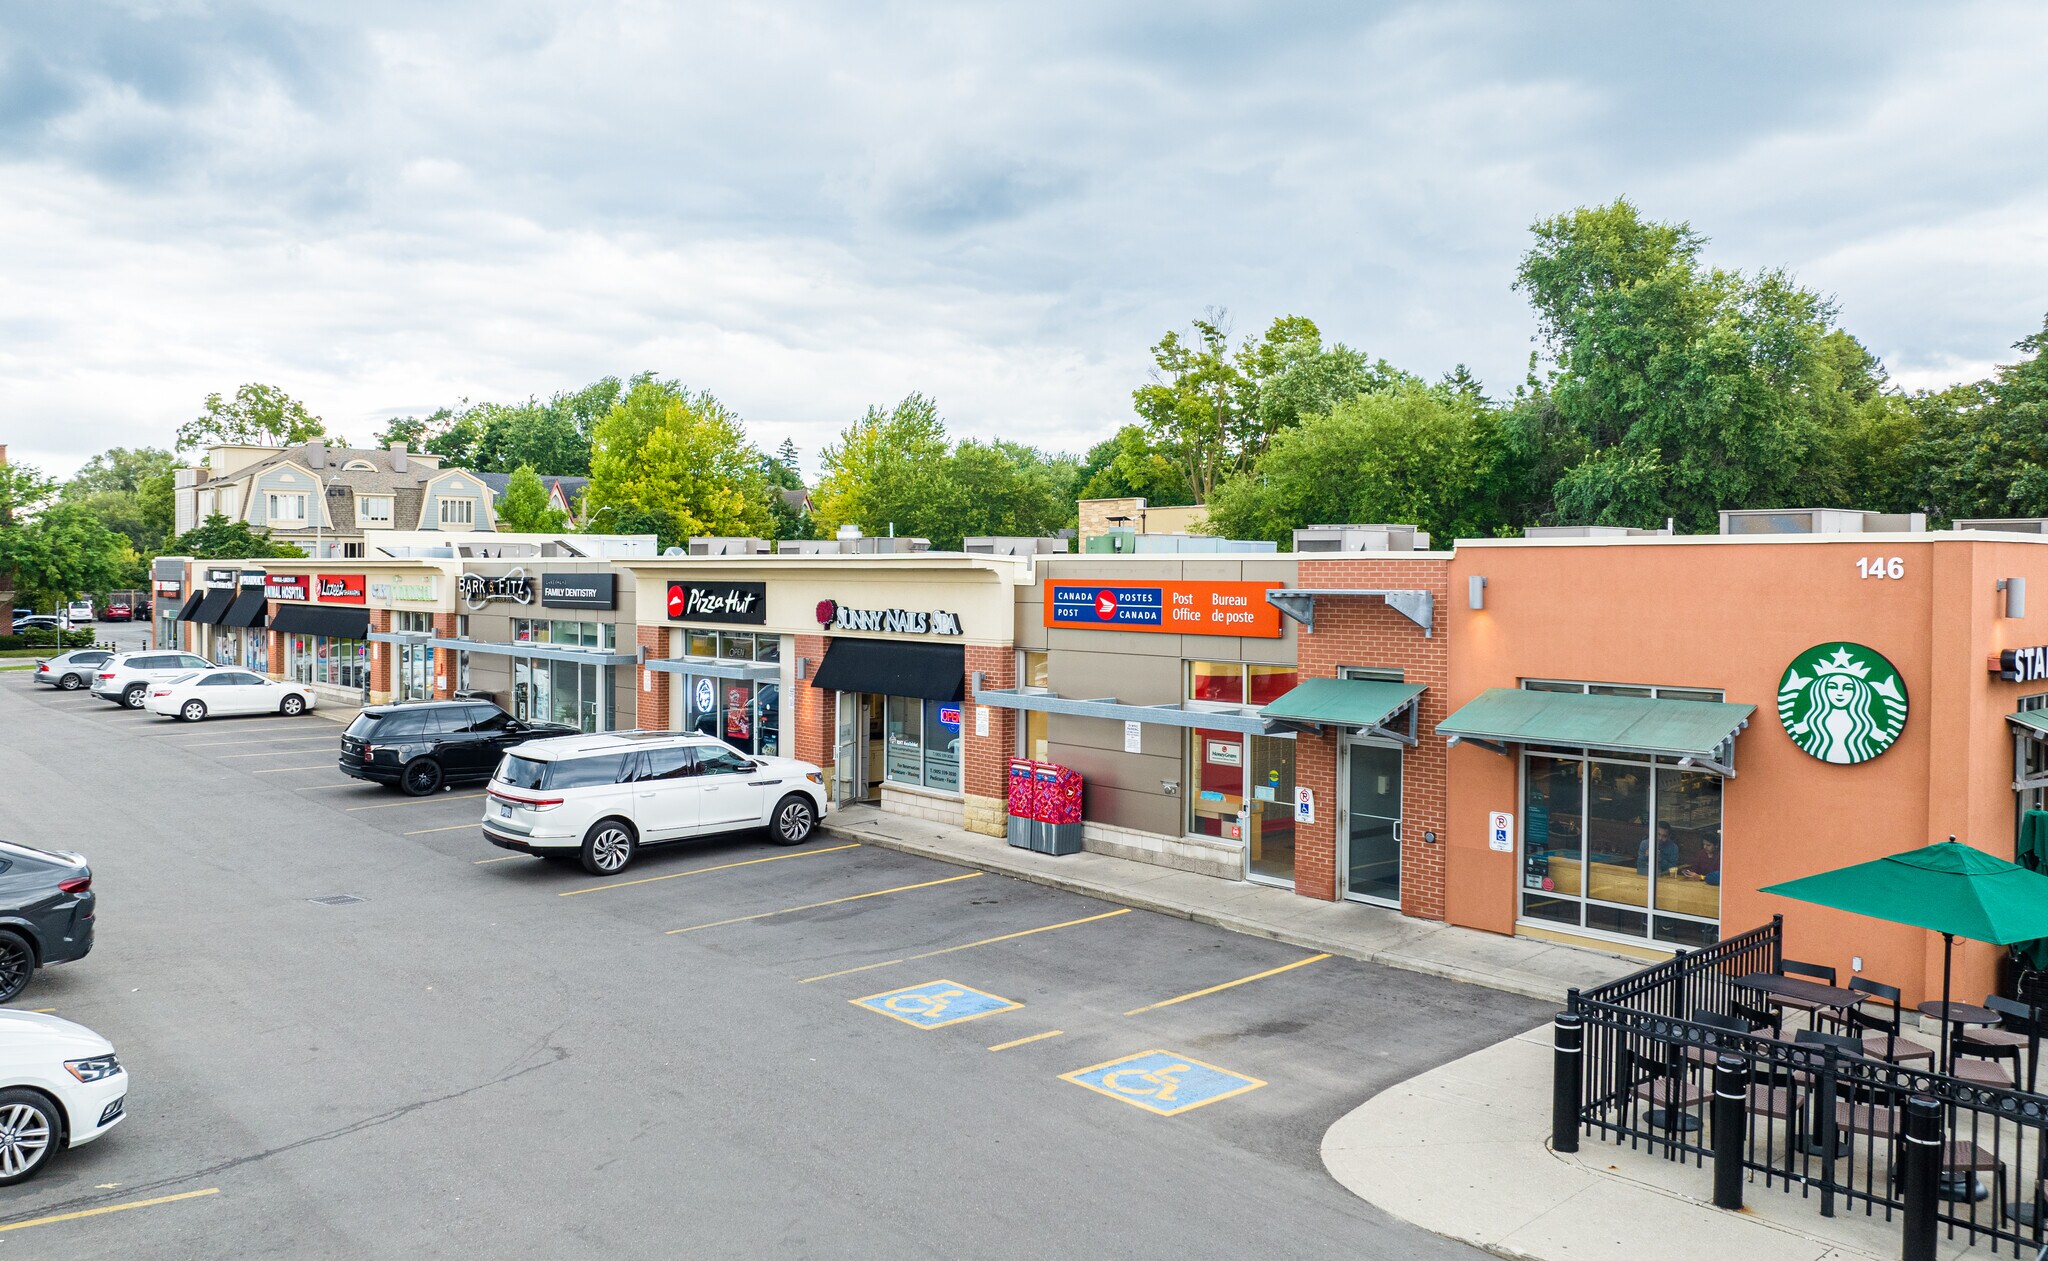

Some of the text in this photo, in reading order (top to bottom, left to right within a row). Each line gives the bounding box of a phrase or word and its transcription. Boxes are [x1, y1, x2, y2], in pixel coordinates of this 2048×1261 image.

[1855, 556, 1905, 580] 146
[263, 585, 305, 600] ANIMAL HOSPITAL
[459, 578, 524, 594] BARK & FITZ
[544, 587, 597, 598] FAMILY DENTISTRY
[686, 588, 756, 614] Pizza Hut
[1057, 591, 1093, 601] CANADA
[1119, 593, 1153, 602] POSTES
[1172, 592, 1194, 605] Post
[1211, 593, 1247, 606] Bureau
[1057, 608, 1079, 617] POST
[1119, 610, 1157, 620] CANADA
[1172, 608, 1201, 621] Office
[1211, 609, 1255, 625] de poste
[836, 606, 960, 635] SUNNY NAILS SPA
[728, 647, 745, 657] OPEN
[2014, 645, 2048, 683] STA
